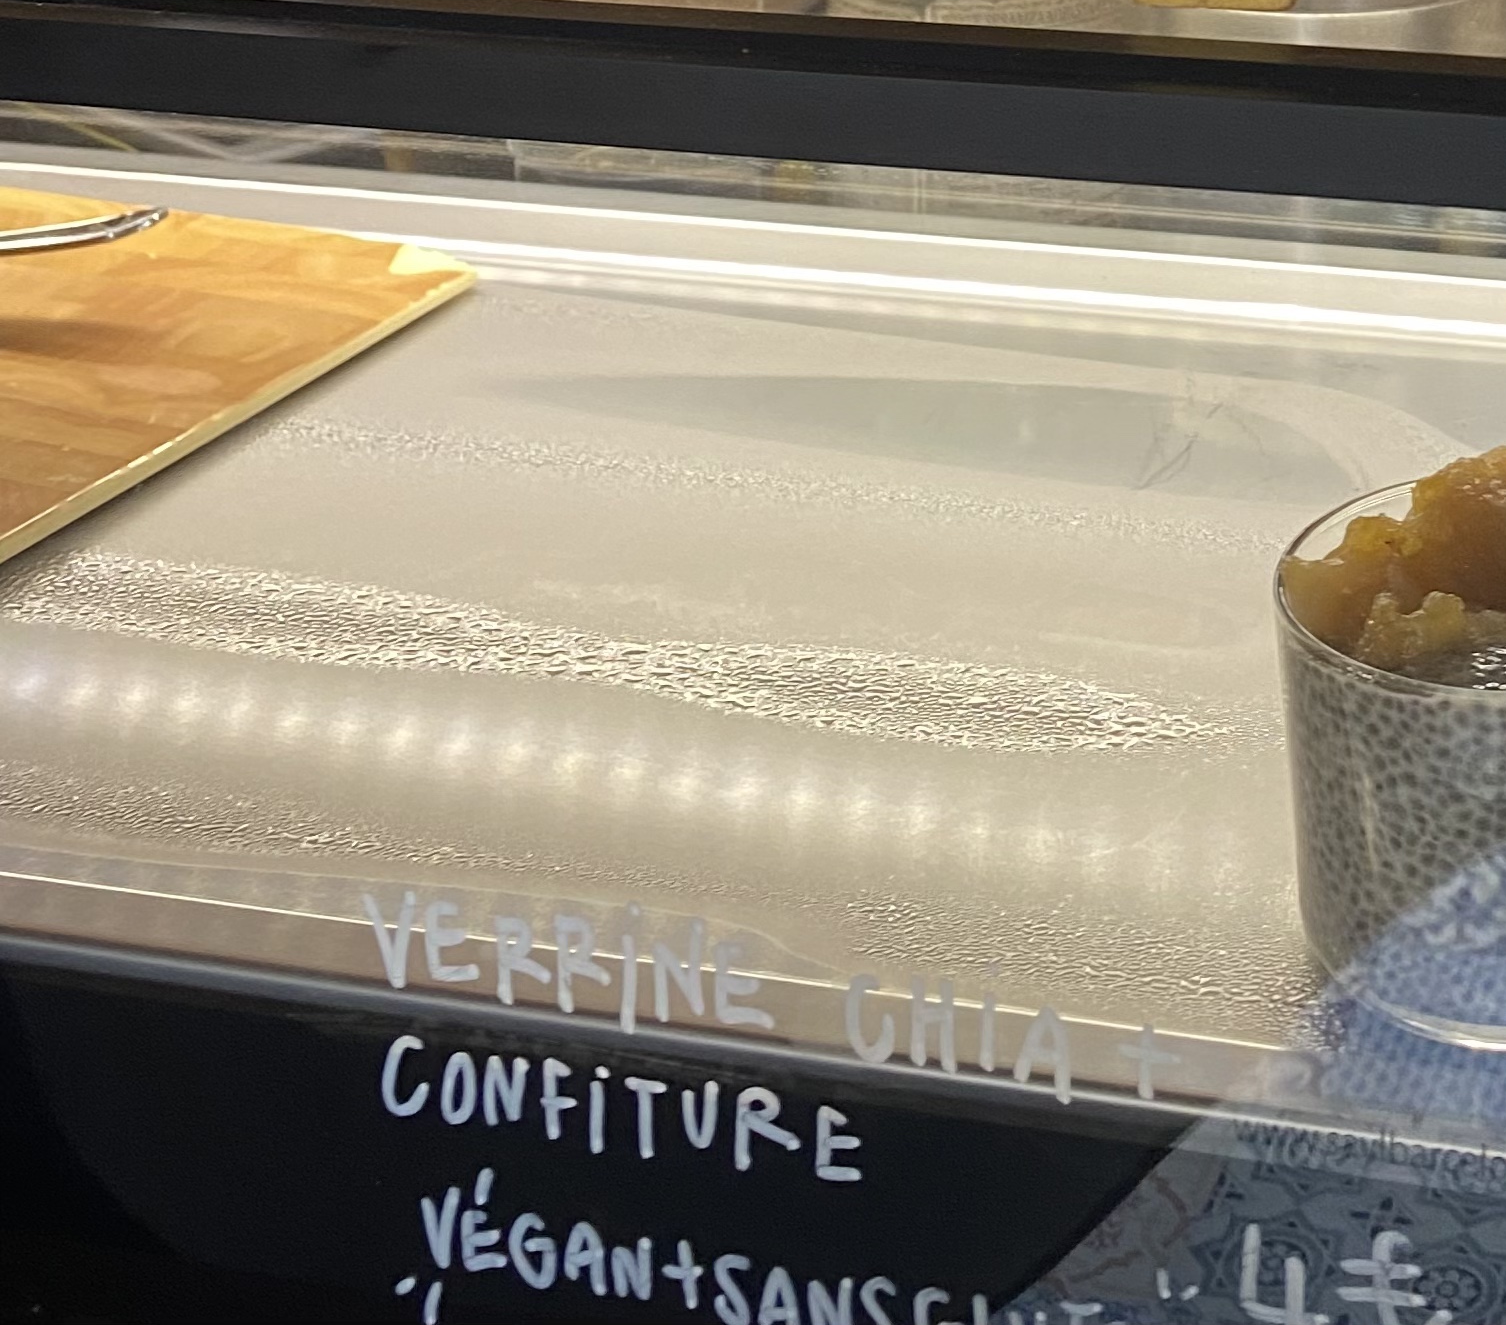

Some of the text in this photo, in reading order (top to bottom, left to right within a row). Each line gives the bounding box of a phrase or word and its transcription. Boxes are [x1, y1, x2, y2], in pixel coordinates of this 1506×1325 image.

[362, 892, 775, 1033] VERRINE
[844, 963, 1071, 1105] CHIA
[381, 1034, 862, 1183] CONFITURE
